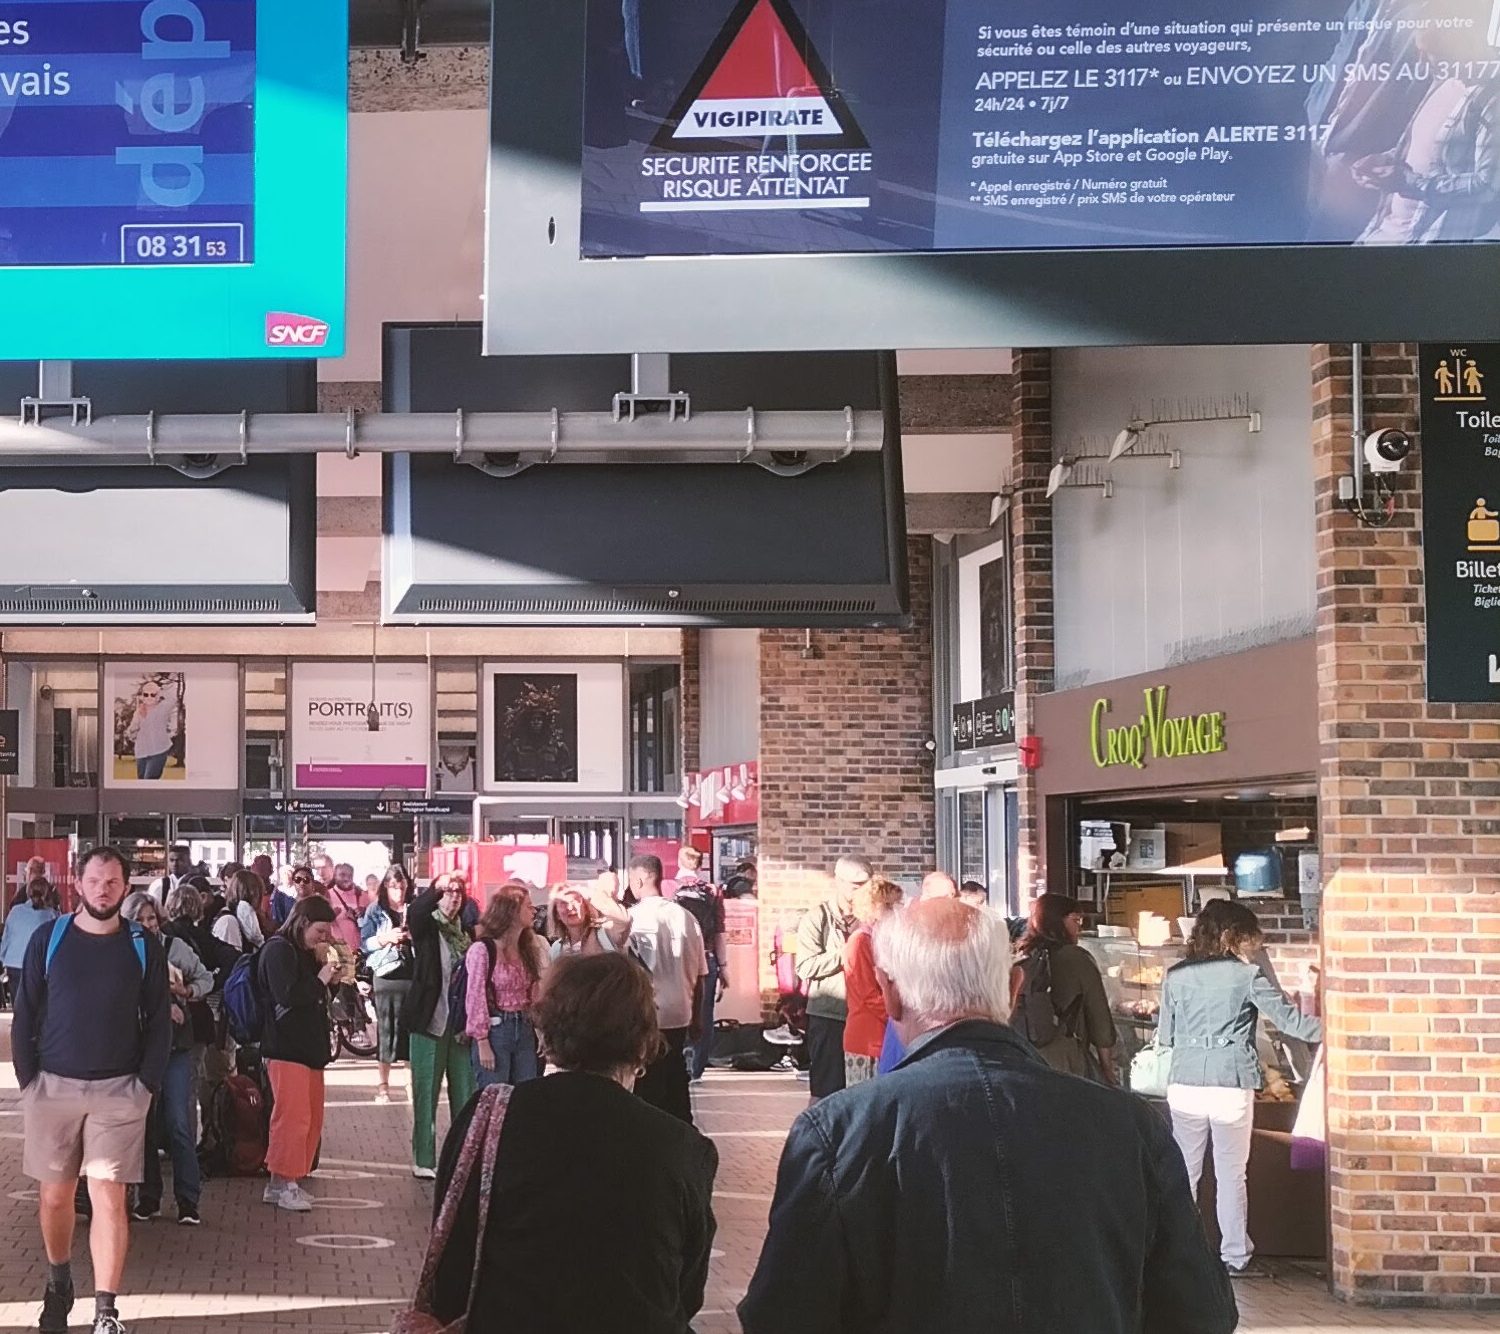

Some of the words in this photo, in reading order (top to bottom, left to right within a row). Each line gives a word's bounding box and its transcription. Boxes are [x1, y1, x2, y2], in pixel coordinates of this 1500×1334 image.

[978, 26, 991, 40] Si
[994, 27, 1028, 39] vous
[1031, 24, 1062, 38] êtes
[1066, 22, 1116, 37] témoin
[1164, 20, 1226, 35] situation
[1230, 19, 1253, 36] qui
[1256, 19, 1321, 36] présente
[1325, 20, 1344, 32] un
[1347, 17, 1393, 34] risque
[1396, 19, 1430, 33] pour
[1434, 17, 1474, 29] votre
[977, 41, 1033, 57] sécurité
[1036, 44, 1055, 56] ou
[1059, 41, 1091, 55] celle
[1096, 40, 1122, 54] des
[1125, 41, 1171, 54] autres
[1174, 40, 1252, 55] voyageurs,
[974, 70, 1068, 90] APPELEZ
[1073, 69, 1099, 88] LE
[1163, 74, 1182, 86] ou
[1186, 64, 1296, 85] ENVOYEZ
[1302, 64, 1336, 82] UN
[1343, 62, 1391, 82] SMS
[1396, 61, 1430, 81] AU
[974, 96, 1025, 112] 24h/24
[1040, 95, 1070, 113] 7j/7
[693, 109, 824, 129] VIGIPIRATE
[972, 129, 1083, 151] Téléchargez
[1204, 125, 1278, 143] ALERTE
[1283, 124, 1332, 141] 3117
[641, 156, 739, 177] SECURITE
[746, 152, 872, 174] RENFORCEE
[971, 152, 1025, 168] gratuite
[1028, 153, 1050, 164] sur
[1053, 149, 1083, 167] App
[1086, 149, 1124, 163] Store
[1127, 149, 1142, 162] et
[1146, 147, 1197, 165] Google
[662, 178, 741, 199] RISQUE
[746, 175, 849, 197] ATTENTAT
[1014, 178, 1071, 195] enregistré
[1081, 177, 1128, 191] Numéro
[1129, 176, 1168, 192] gratuit
[1010, 193, 1067, 207] enregistré
[1077, 192, 1099, 207] prix
[1101, 192, 1127, 204] SMS
[1129, 191, 1145, 203] de
[1147, 192, 1177, 203] votre
[268, 324, 328, 343] SNCF
[1449, 348, 1468, 357] WC
[308, 701, 413, 719] PORTRAIT(S)
